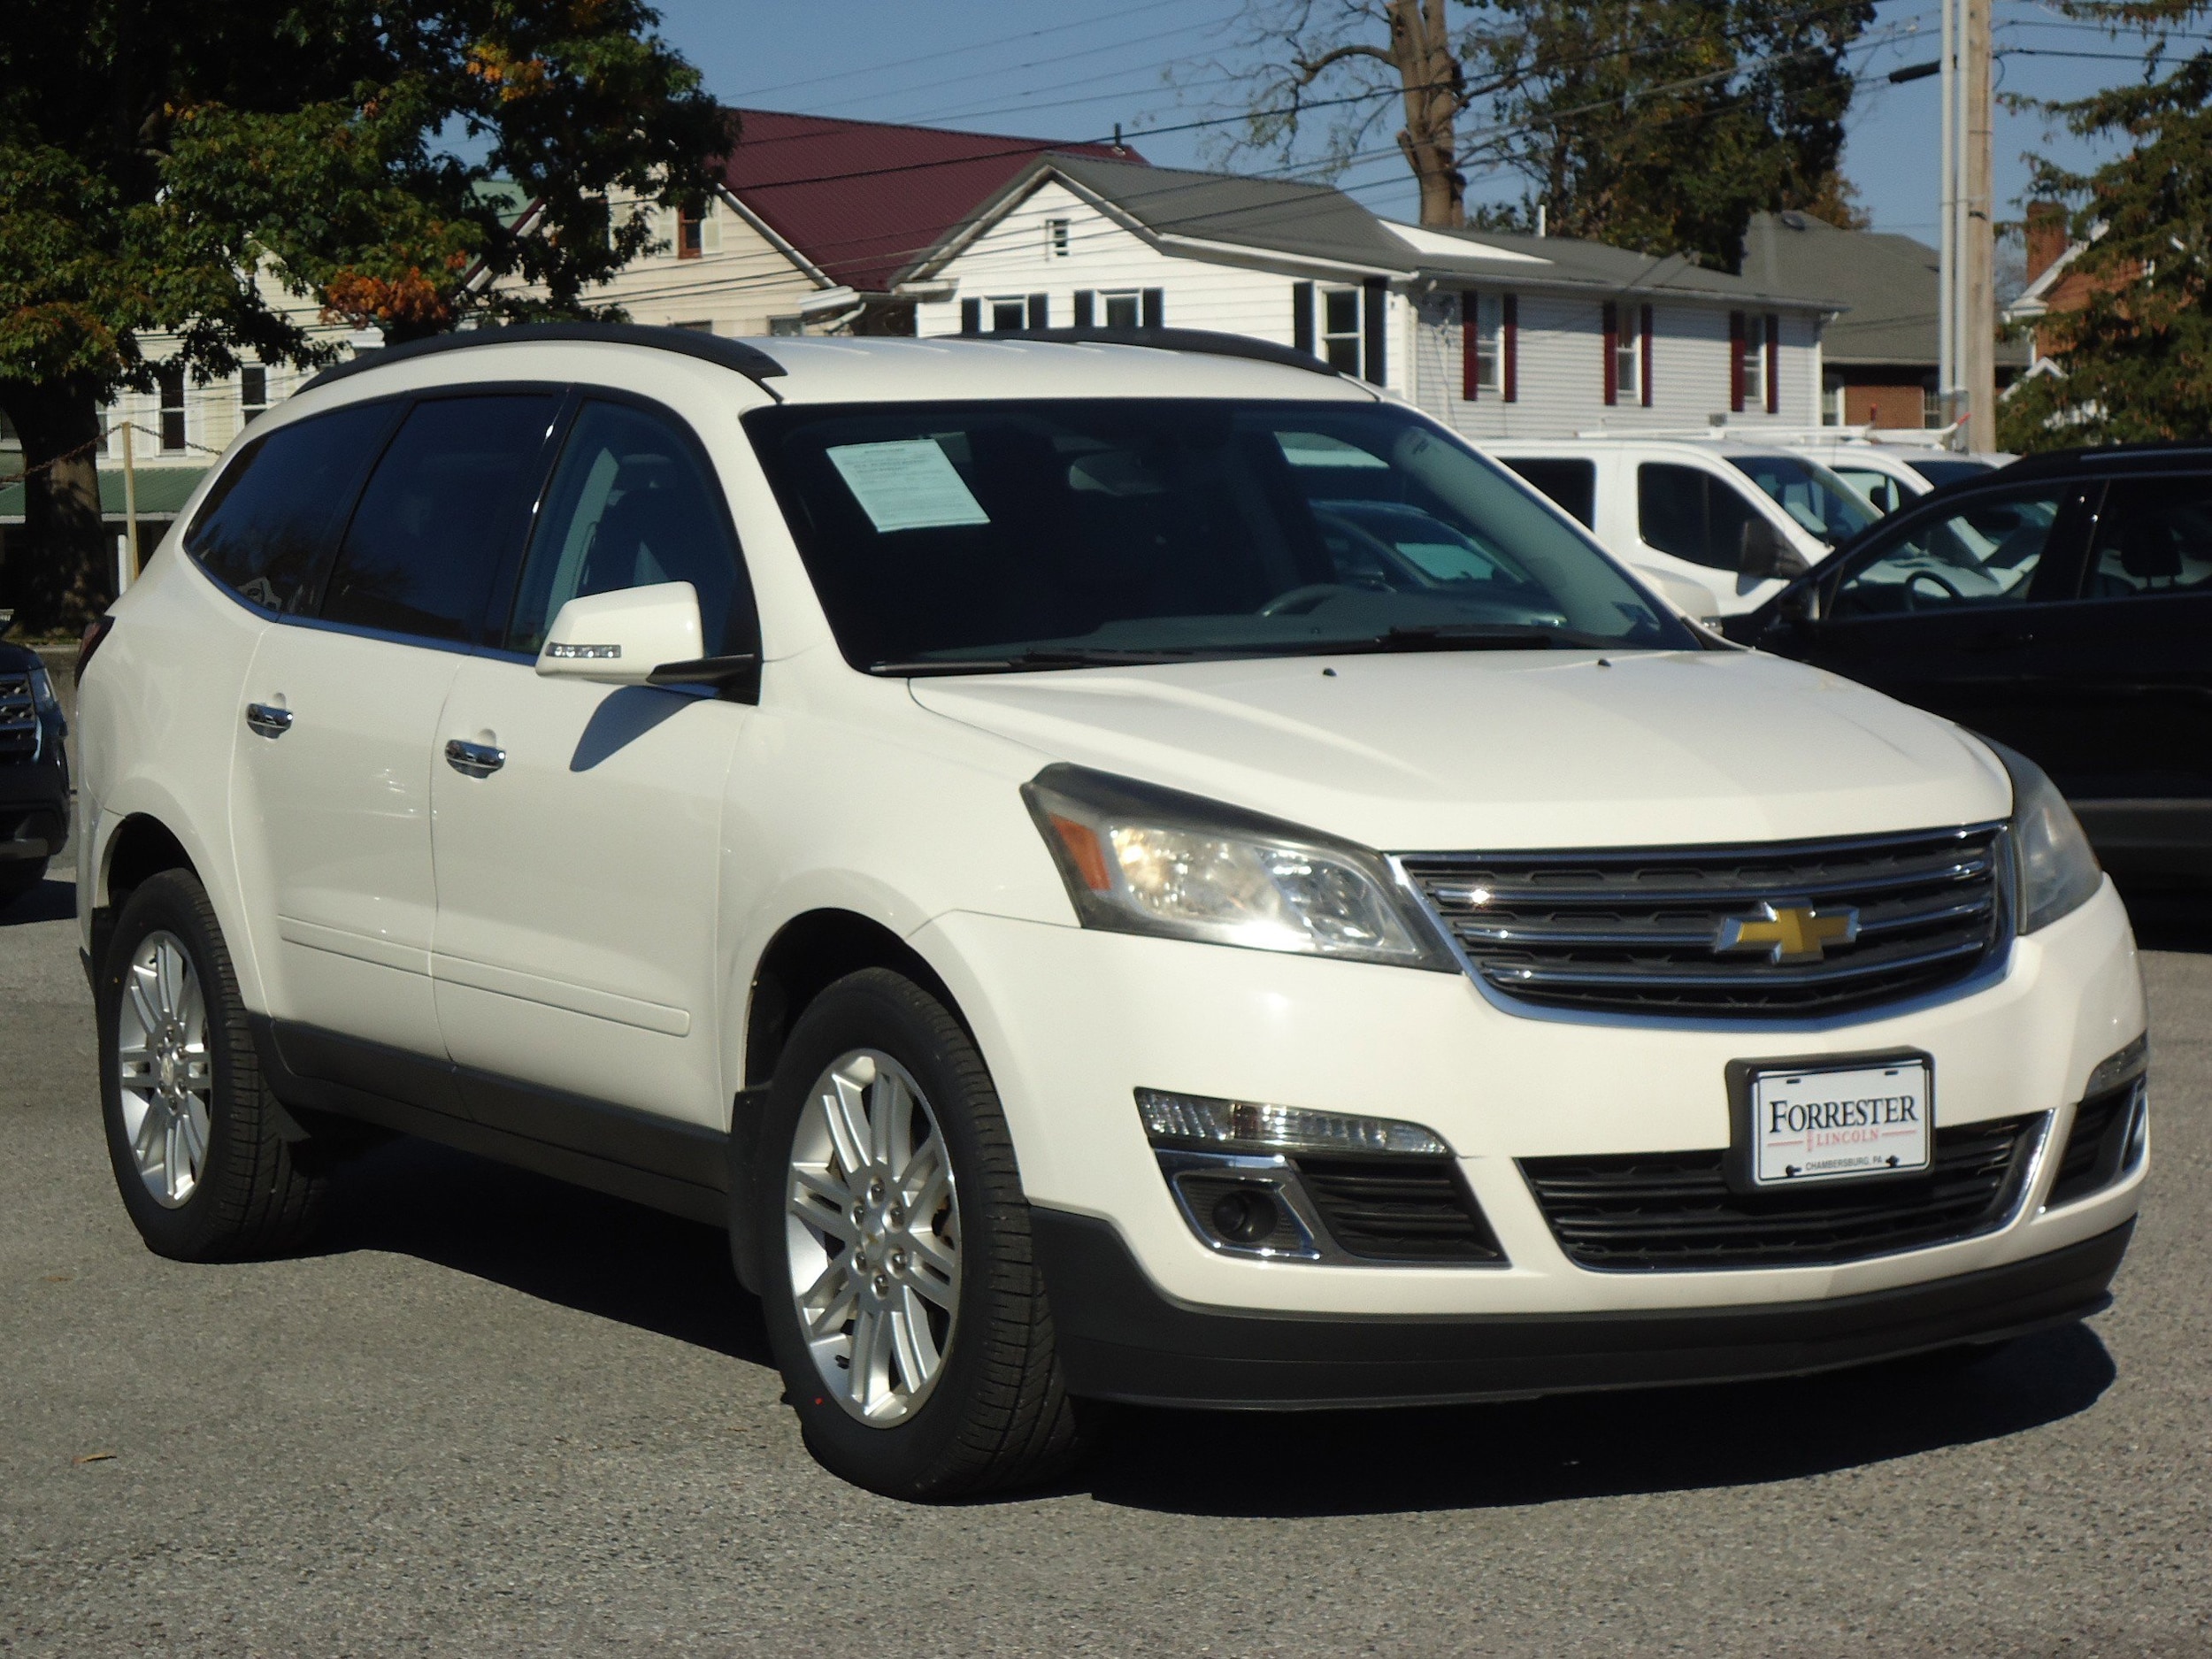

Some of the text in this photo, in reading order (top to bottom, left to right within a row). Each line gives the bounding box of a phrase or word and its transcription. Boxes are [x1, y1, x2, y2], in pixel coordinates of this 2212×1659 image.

[1770, 1095, 1918, 1133] FORRESTER
[1816, 1128, 1879, 1148] LINCOLN
[1872, 1156, 1883, 1164] PA
